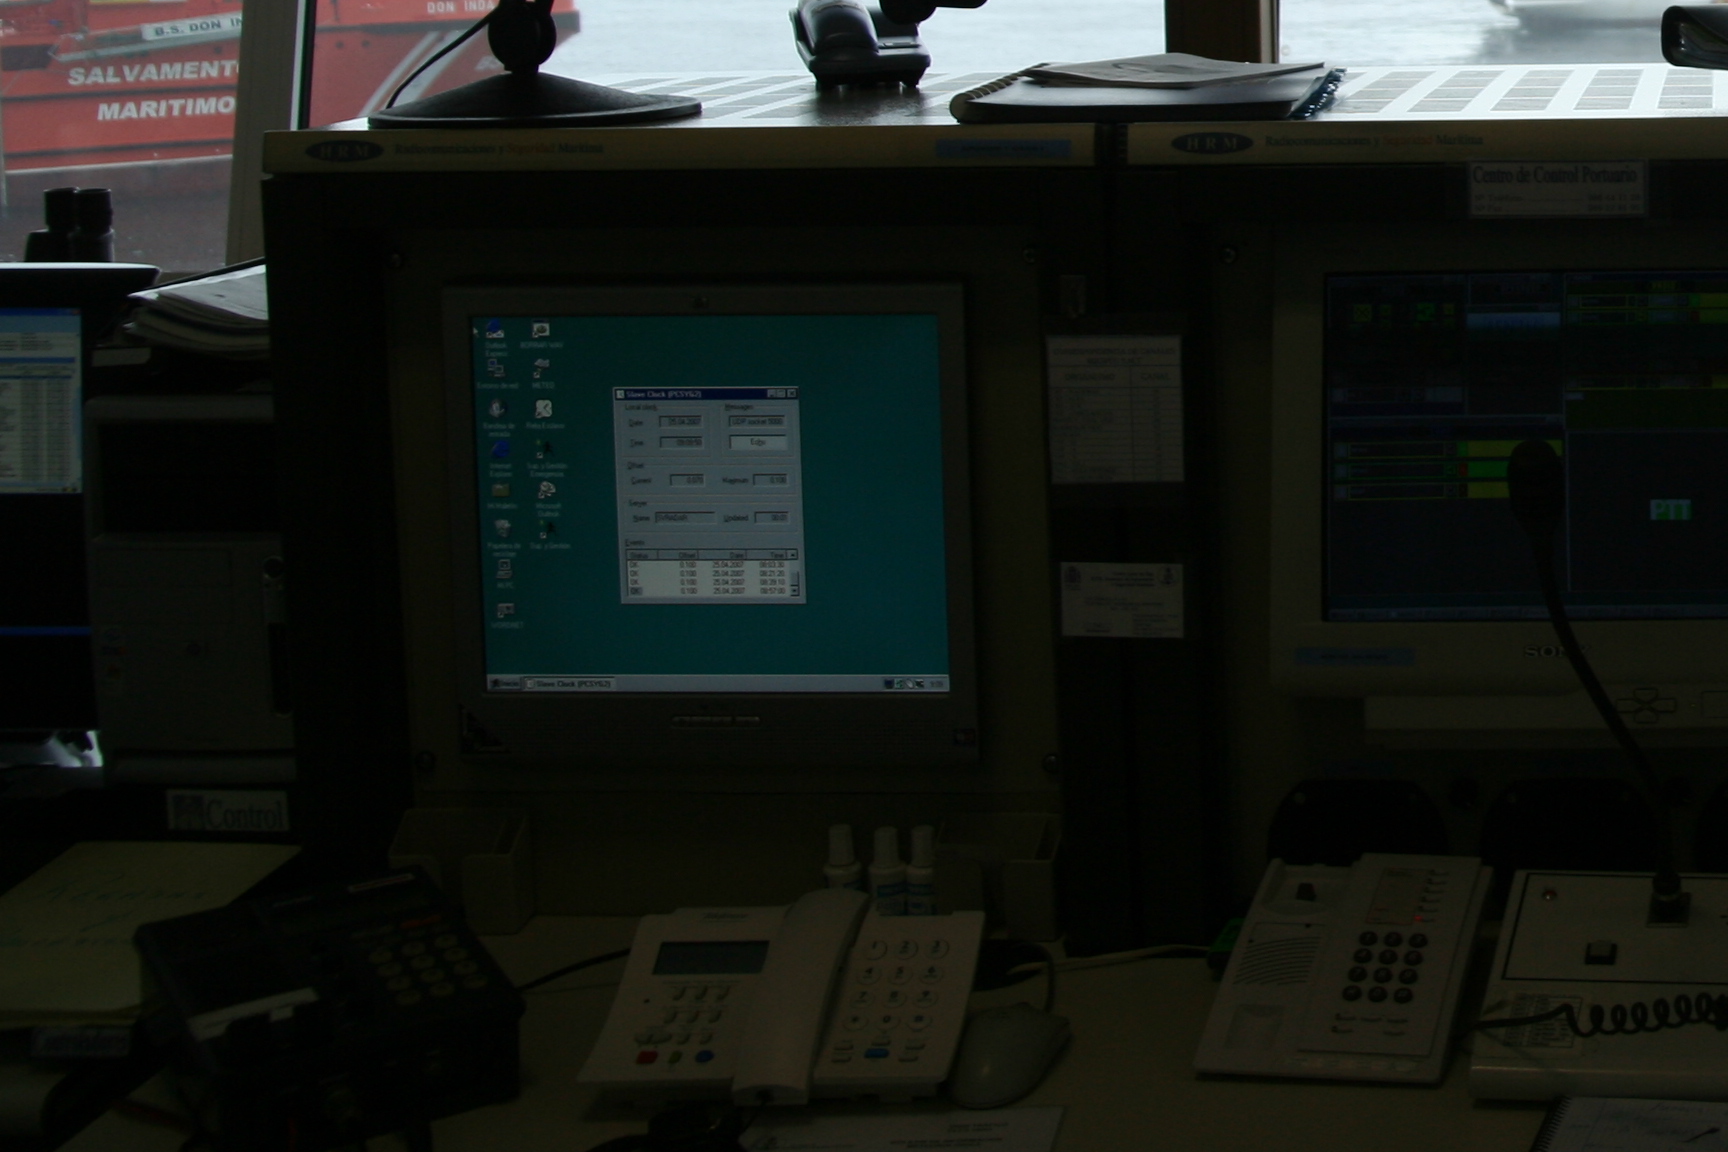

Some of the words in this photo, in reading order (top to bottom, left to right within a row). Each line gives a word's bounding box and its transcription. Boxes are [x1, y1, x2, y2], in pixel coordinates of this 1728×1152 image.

[426, 1, 455, 14] DON
[155, 23, 184, 36] B.S.
[190, 19, 221, 32] DON
[67, 59, 239, 86] SALVAMENT
[97, 96, 237, 122] MARITIMO
[1265, 135, 1371, 147] Radiocomunicaciones
[1382, 135, 1433, 147] Seguridad
[1472, 166, 1513, 184] Centro
[1516, 166, 1531, 183] de
[1533, 166, 1579, 184] Control
[1582, 165, 1638, 184] Portuario
[626, 390, 646, 399] Slave
[646, 390, 666, 399] Clock
[1650, 498, 1692, 521] PTT
[770, 551, 784, 559] Time
[629, 569, 639, 577] OK
[712, 569, 745, 577] 25.04.2007
[630, 578, 639, 586] OK
[713, 578, 745, 586] 25.04.2007
[630, 587, 640, 595] OK
[713, 587, 746, 595] 25.04.2007
[557, 680, 575, 688] Clock
[206, 798, 285, 829] Control
